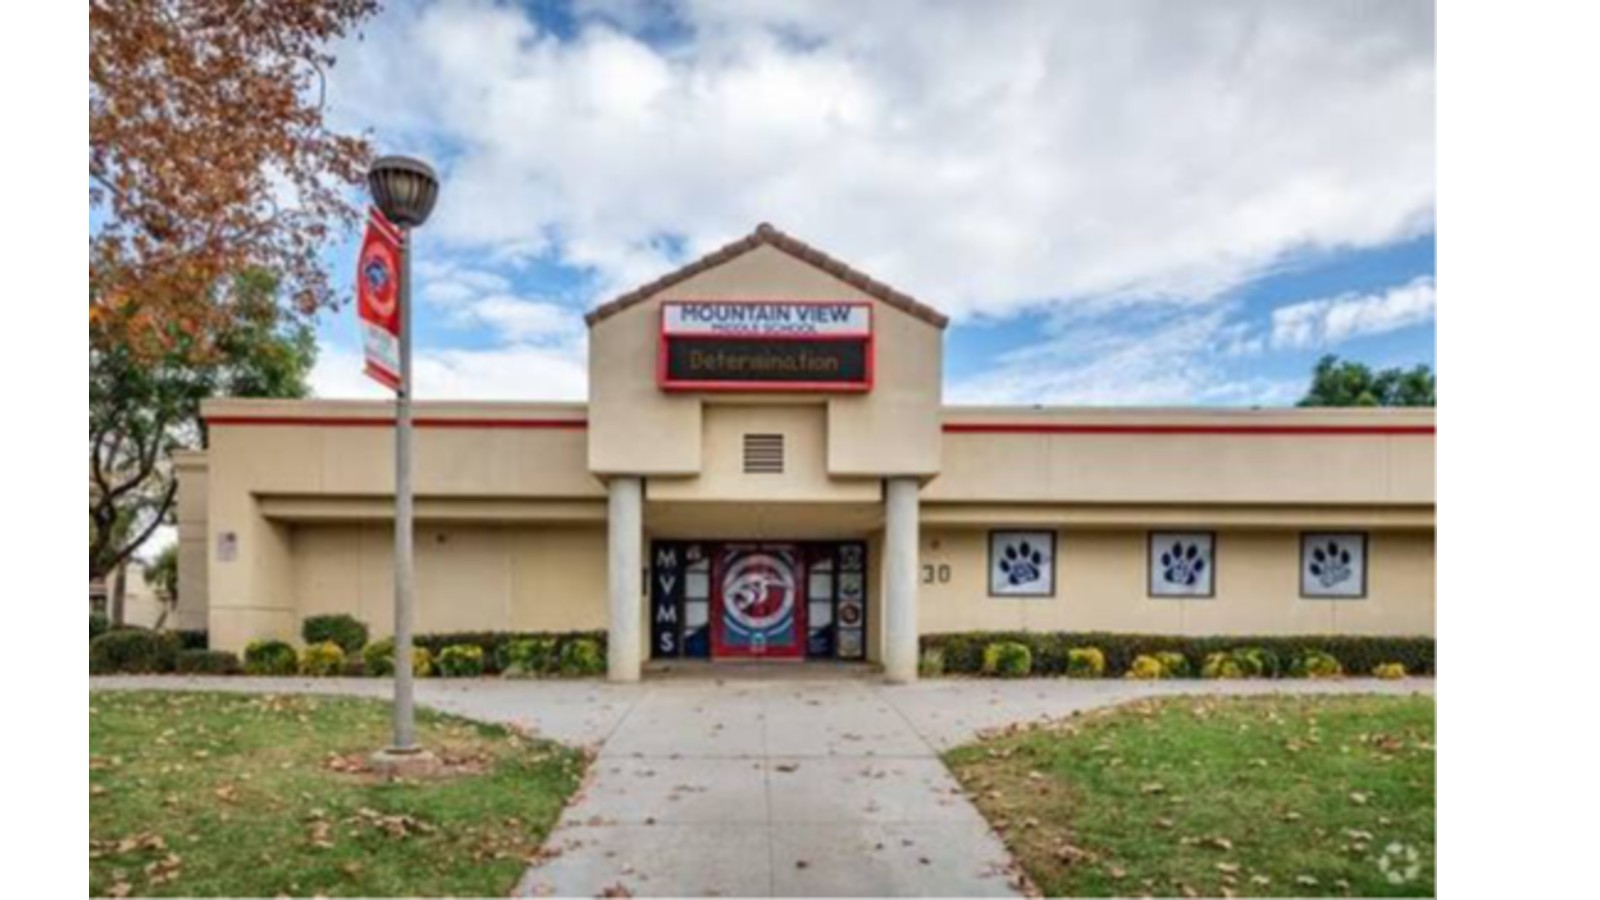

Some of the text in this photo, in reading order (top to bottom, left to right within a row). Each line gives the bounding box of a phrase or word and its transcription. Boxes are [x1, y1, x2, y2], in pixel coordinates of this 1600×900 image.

[680, 304, 850, 323] MOUNTAIN VIEW
[689, 350, 839, 371] Determination
[922, 564, 951, 584] 30
